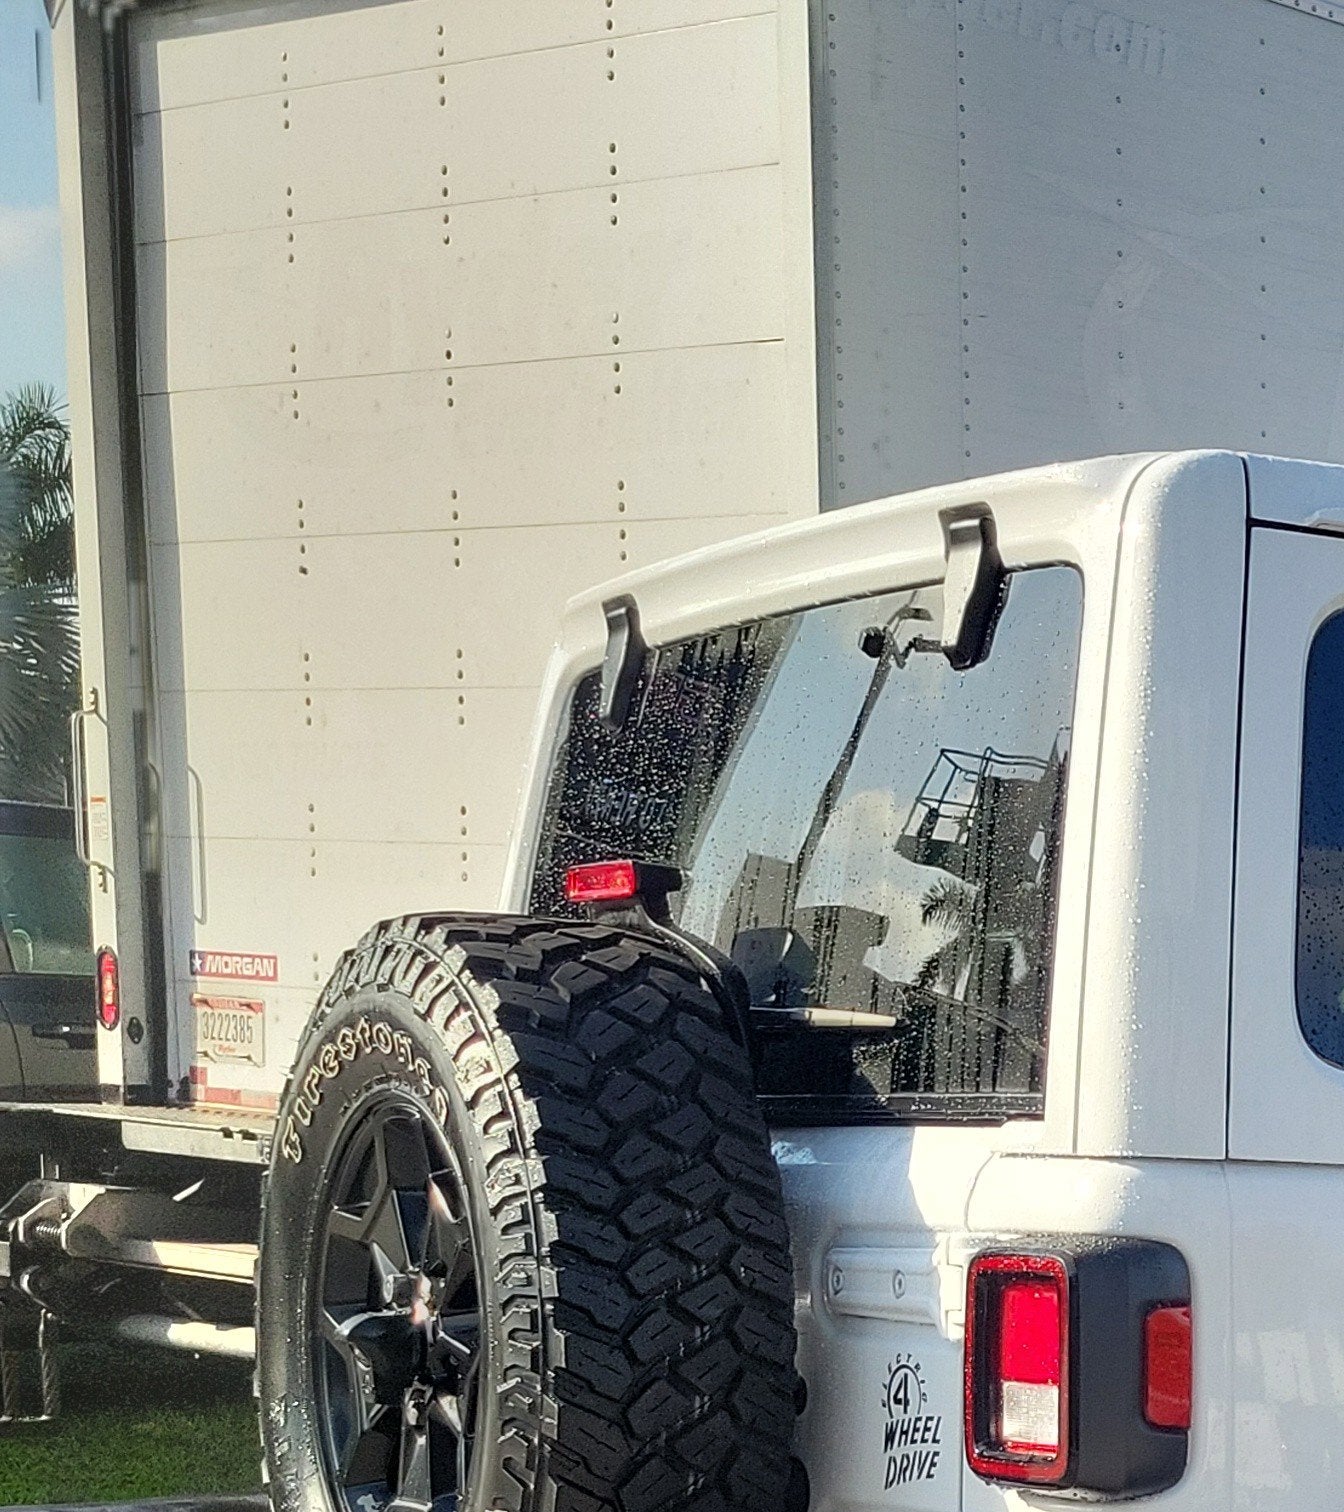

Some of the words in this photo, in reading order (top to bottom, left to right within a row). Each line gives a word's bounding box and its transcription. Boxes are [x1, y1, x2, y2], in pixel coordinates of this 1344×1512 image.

[205, 954, 276, 977] MORGAN
[202, 1011, 253, 1043] 3222385
[892, 1372, 910, 1414] 4
[884, 1416, 942, 1454] WHEEL
[884, 1450, 941, 1490] DRIVE
